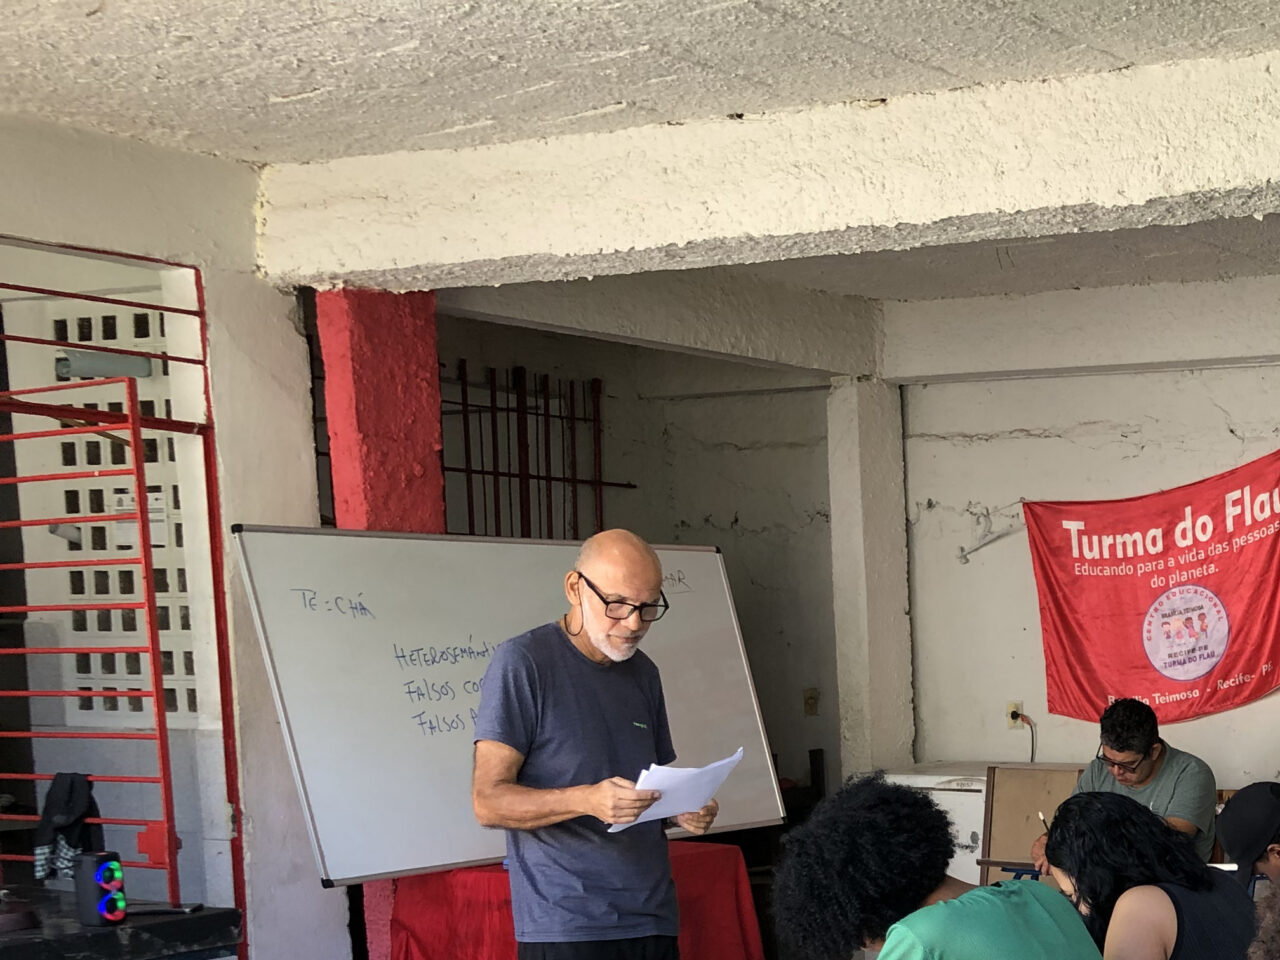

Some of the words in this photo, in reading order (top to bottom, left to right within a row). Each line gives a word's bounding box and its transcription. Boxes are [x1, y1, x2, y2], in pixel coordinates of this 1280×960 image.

[1062, 519, 1163, 560] Turma
[1174, 505, 1214, 549] do
[1074, 562, 1133, 576] Educando
[1137, 560, 1165, 577] para
[1167, 558, 1175, 568] a
[1178, 549, 1205, 565] vida
[1207, 541, 1229, 558] das
[1232, 524, 1280, 550] pessoas
[1150, 575, 1166, 589] do
[1168, 564, 1219, 588] planeta.
[1152, 688, 1199, 704] Teimosa
